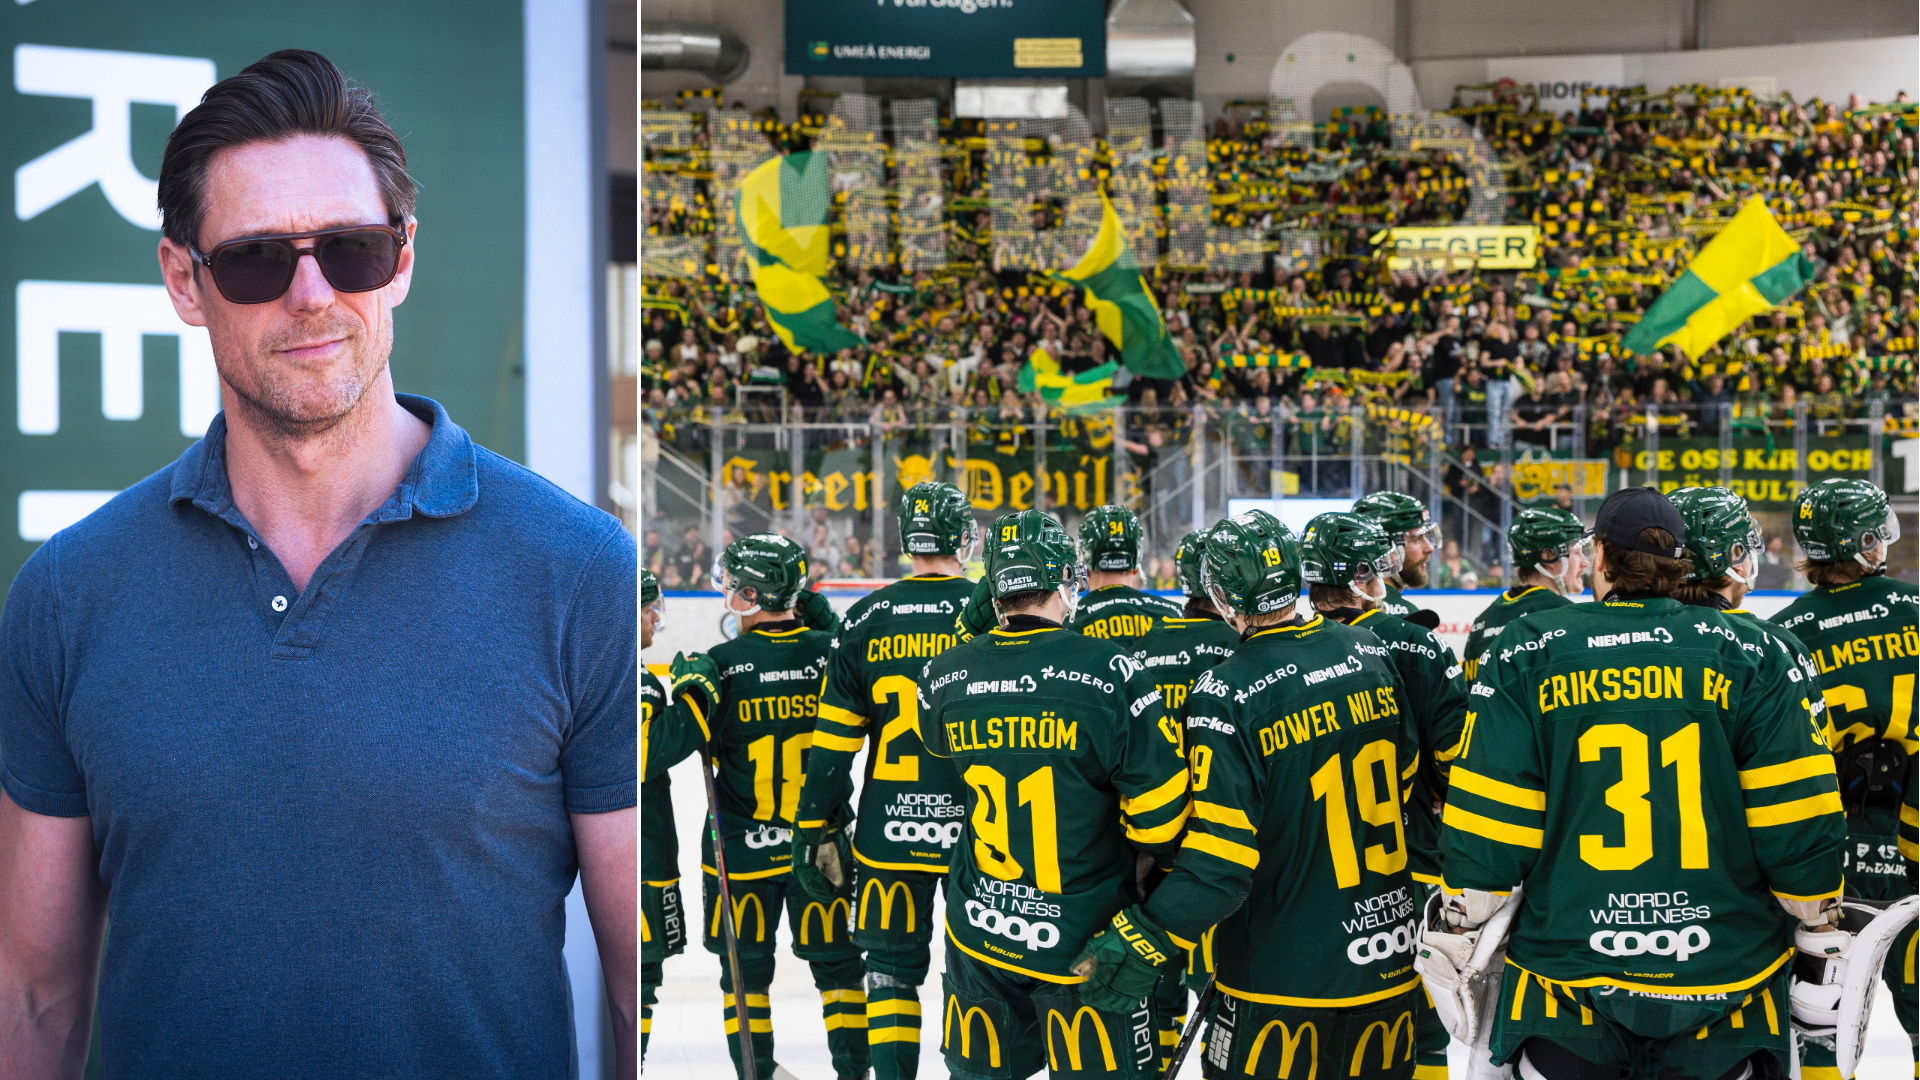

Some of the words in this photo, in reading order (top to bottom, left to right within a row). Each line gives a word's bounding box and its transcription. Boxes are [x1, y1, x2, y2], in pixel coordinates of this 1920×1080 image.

[833, 43, 876, 58] UMEÅ
[878, 46, 931, 59] ENERGI
[1635, 450, 1675, 471] GE
[1680, 449, 1738, 471] OSS
[1807, 449, 1872, 471] OCH
[914, 499, 929, 514] 24
[1800, 503, 1813, 519] 64
[1001, 525, 1017, 542] 91
[1109, 521, 1124, 535] 34
[1262, 547, 1281, 567] 19
[1007, 576, 1032, 585] BASTU
[892, 604, 923, 614] NIEMI
[1269, 593, 1293, 606] BASTU
[855, 600, 890, 626] ADERO
[1818, 613, 1853, 630] NIEMI
[1083, 615, 1153, 639] BRODIN
[1390, 641, 1437, 659] ADERO
[1513, 629, 1566, 655] ADERO
[1587, 633, 1630, 648] NIEMI
[1811, 625, 1919, 675] LMSTRÖ
[1145, 656, 1164, 668] NIEMI
[759, 672, 789, 683] NIEMI
[935, 669, 968, 688] ADERO
[967, 681, 999, 695] NIEMI
[1054, 669, 1115, 694] ADERO
[1191, 670, 1230, 698] Diös
[1248, 663, 1298, 696] ADERO
[1303, 668, 1335, 687] NIEMI
[1539, 665, 1683, 714] ERIKSSON
[739, 694, 821, 722] OTTOSS
[945, 711, 1078, 752] ELLSTRÖM
[1259, 701, 1340, 756] DOWER
[897, 793, 952, 806] NORDIC
[1578, 722, 1709, 871] 31
[885, 804, 964, 818] WELLNESS
[1310, 739, 1408, 889] 19
[884, 821, 962, 848] coop
[964, 765, 1062, 894] 91
[979, 877, 1044, 900] NORDIC
[1354, 886, 1408, 916] NORDIC
[965, 899, 1060, 951] coop
[1342, 898, 1414, 934] WELLNESS
[1590, 906, 1711, 925] WELLNESS
[990, 945, 1023, 960] BAUER
[1347, 919, 1417, 965] coop
[1589, 925, 1711, 961] coop
